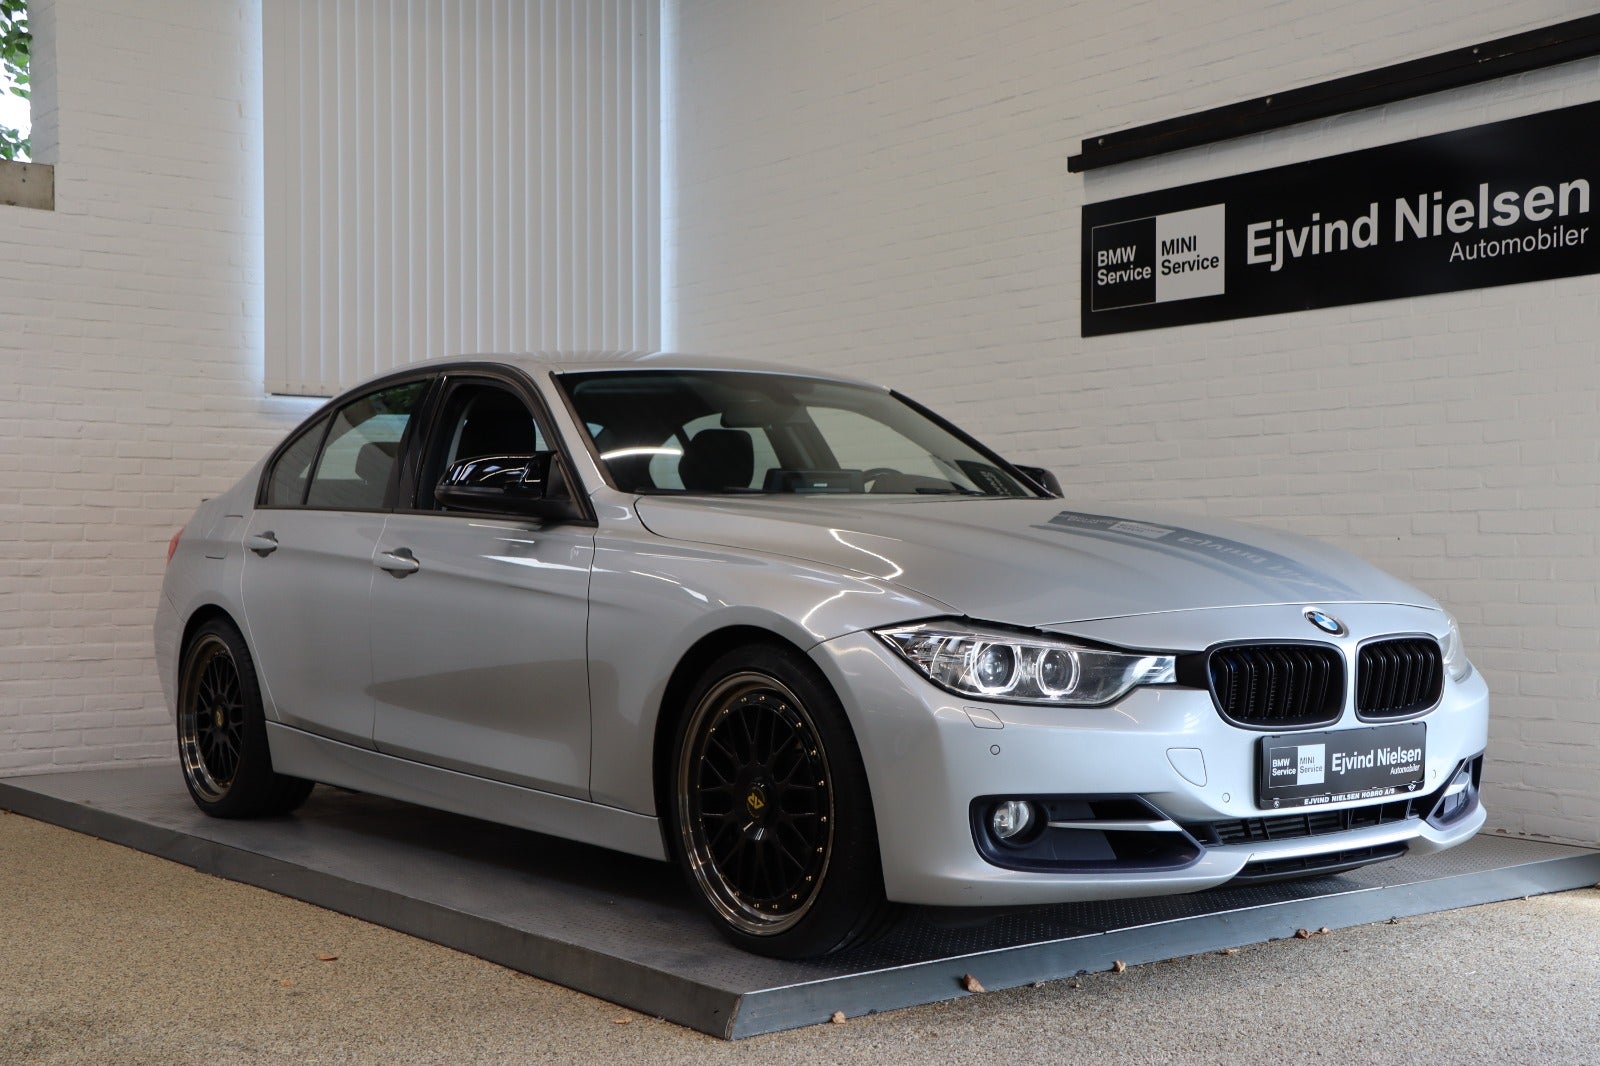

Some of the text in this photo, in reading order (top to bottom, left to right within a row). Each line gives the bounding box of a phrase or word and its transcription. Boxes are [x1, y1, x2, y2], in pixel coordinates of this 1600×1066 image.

[1246, 177, 1591, 272] Ejvind Nielsen
[1161, 235, 1197, 258] MINI
[1448, 224, 1590, 262] Automobiler
[1097, 245, 1137, 268] BMW
[1161, 253, 1220, 277] Service
[1096, 264, 1152, 286] Service
[1272, 758, 1290, 768] BMW
[1299, 756, 1315, 765] MINI
[1299, 765, 1323, 774] Service
[1331, 746, 1422, 774] Ejvind Nielsen
[1389, 763, 1421, 776] Automobiler
[1272, 767, 1297, 777] Service
[1304, 788, 1395, 805] EJVIND NIELSEN HOBRO A/S
